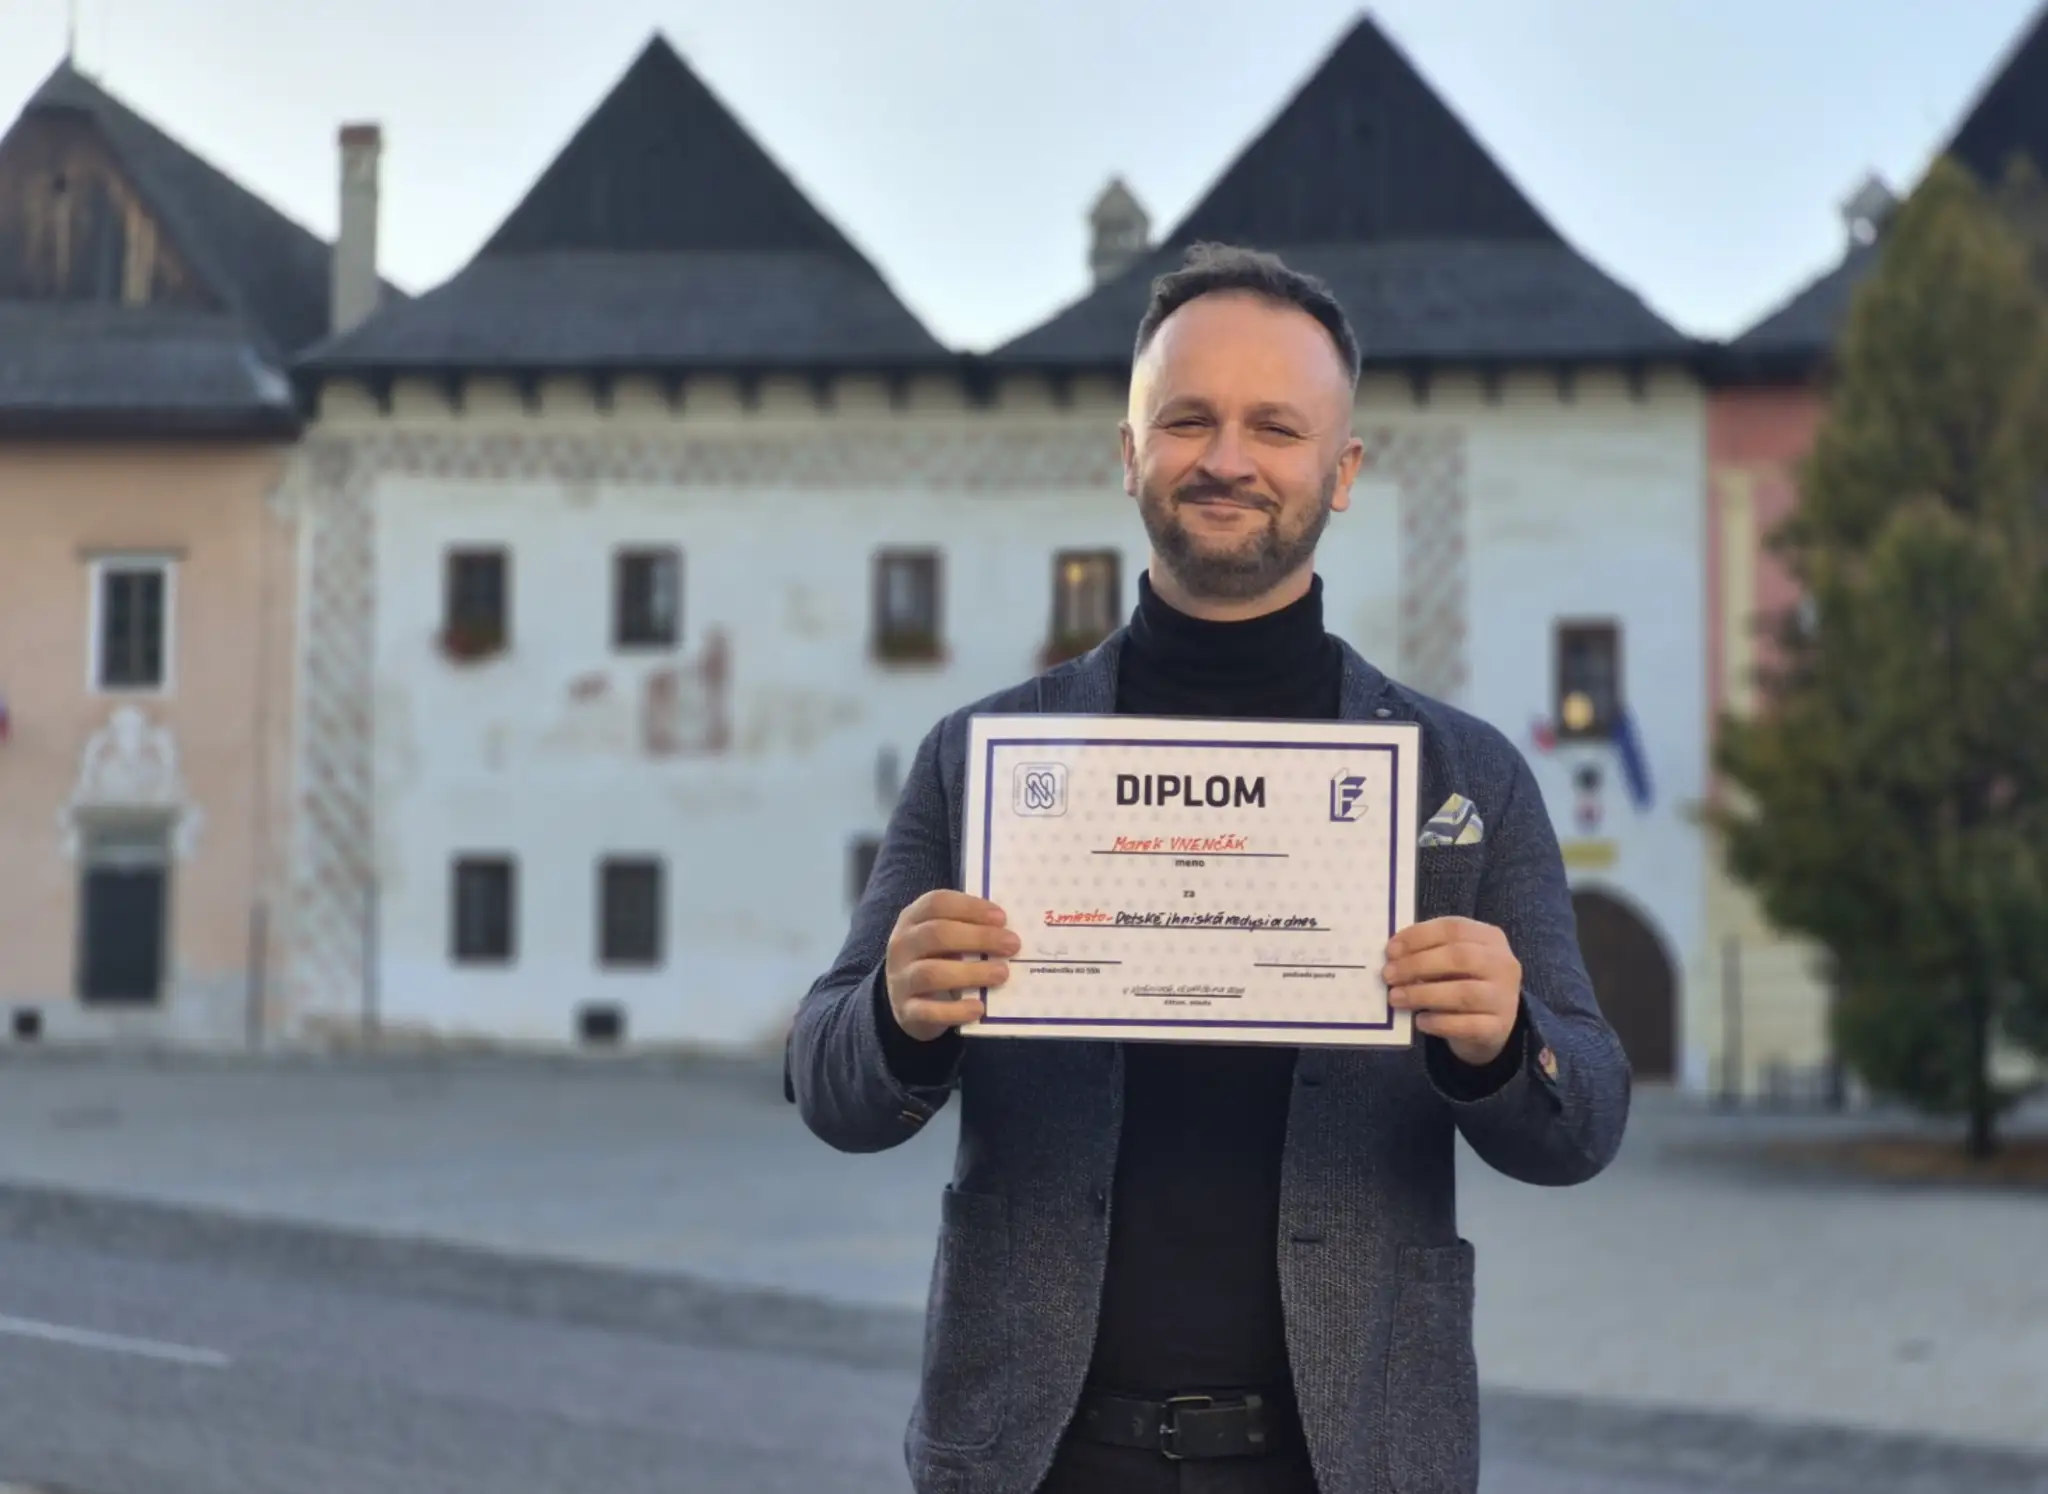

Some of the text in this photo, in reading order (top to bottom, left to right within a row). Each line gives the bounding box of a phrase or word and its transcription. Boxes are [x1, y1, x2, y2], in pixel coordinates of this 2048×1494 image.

[1116, 774, 1266, 809] DIPLOM
[1112, 834, 1248, 852] Marek VNENČÁK
[1175, 859, 1205, 868] meno
[1183, 890, 1195, 898] za
[1284, 915, 1318, 927] dnes
